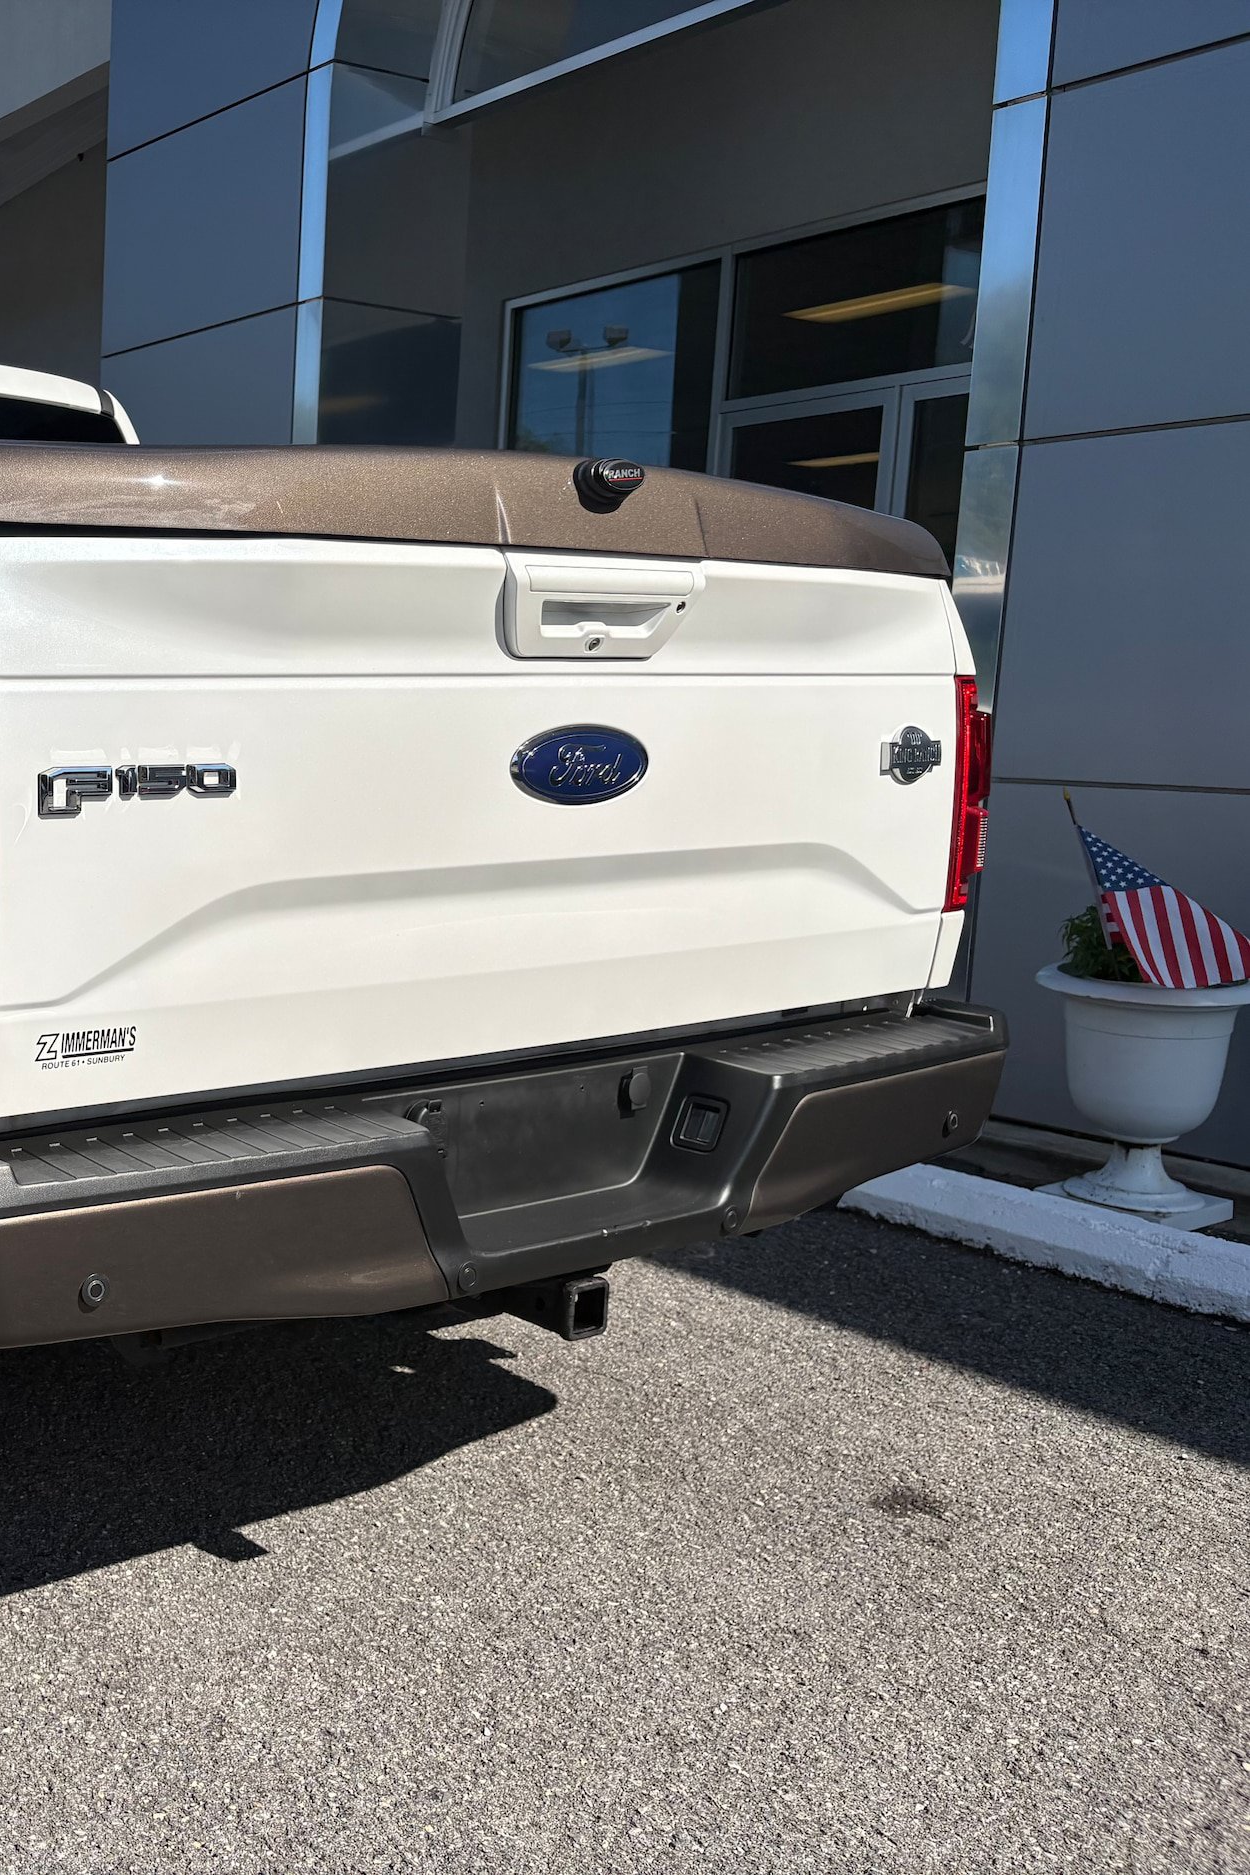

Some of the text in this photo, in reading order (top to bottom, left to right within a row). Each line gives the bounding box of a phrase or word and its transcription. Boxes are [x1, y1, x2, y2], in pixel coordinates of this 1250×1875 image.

[607, 467, 641, 479] RANCH
[548, 742, 624, 788] Ford
[34, 1025, 137, 1062] ZIMMERMAN'S
[41, 1053, 126, 1071] ROUTE 61 SUNBURY
